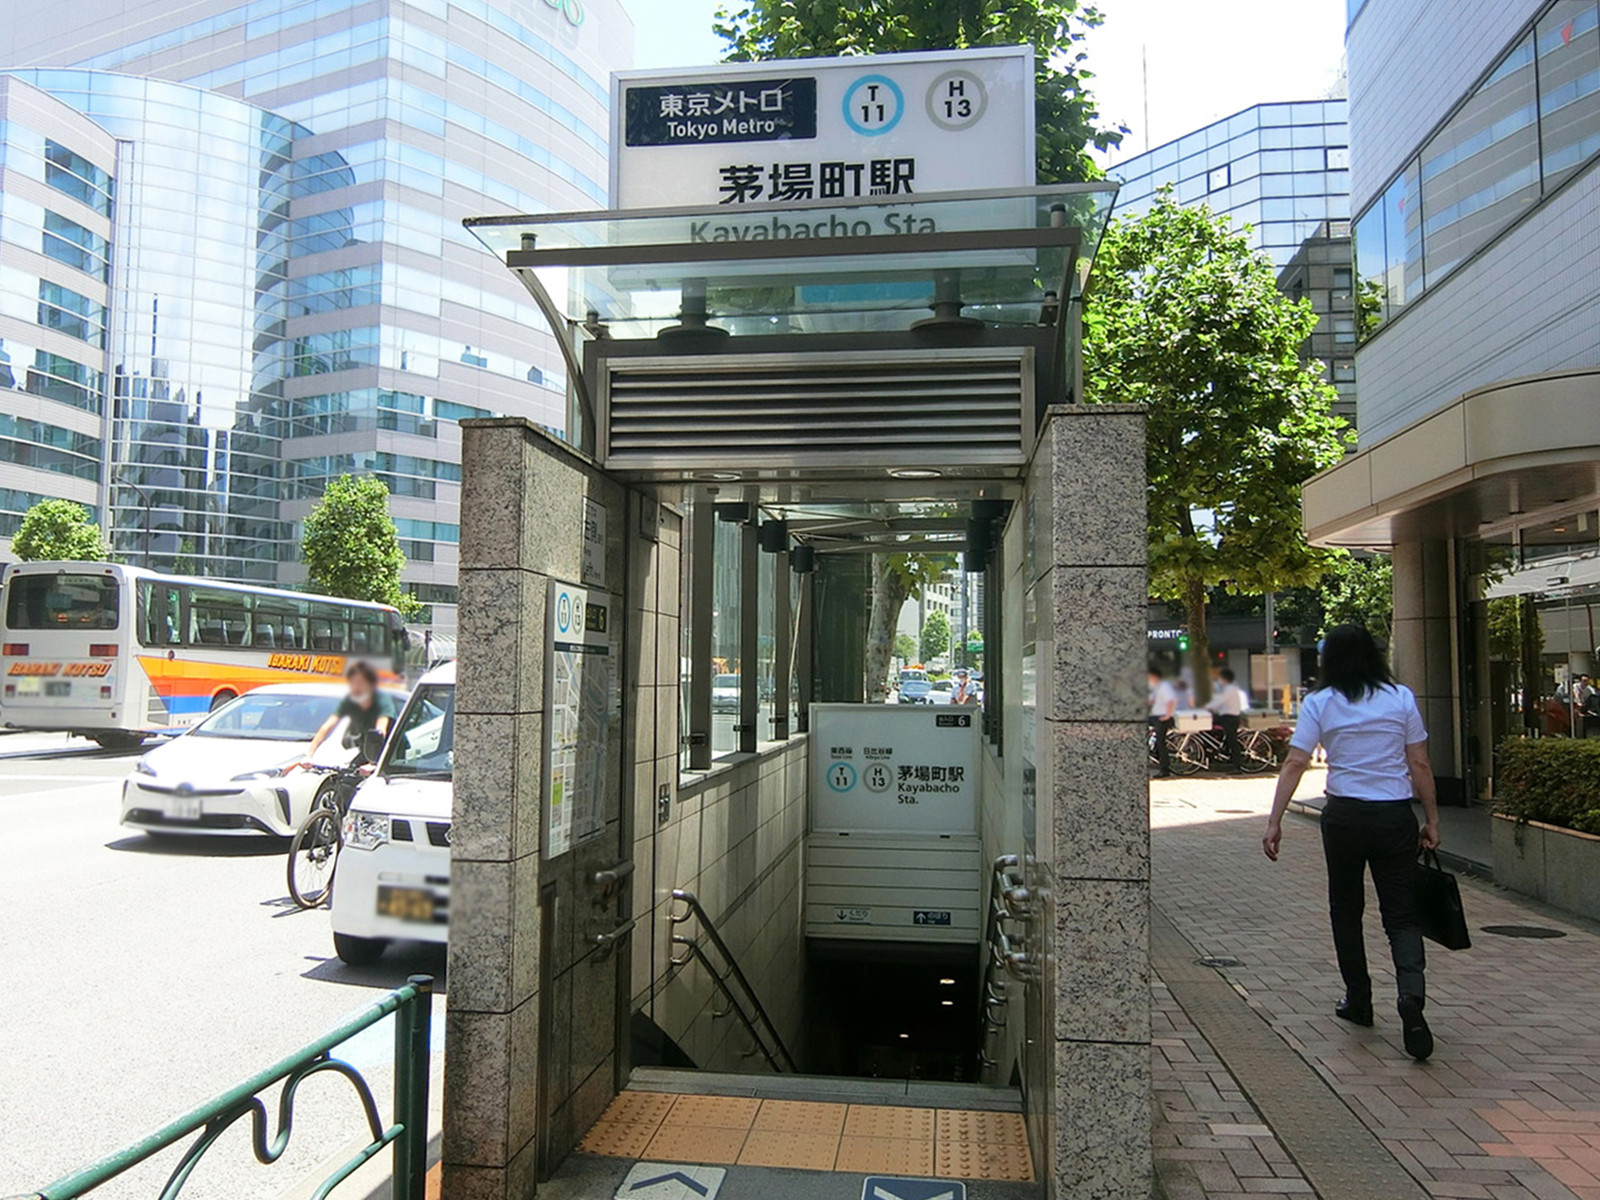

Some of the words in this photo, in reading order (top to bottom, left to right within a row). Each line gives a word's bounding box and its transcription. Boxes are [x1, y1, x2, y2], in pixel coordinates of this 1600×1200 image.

[867, 85, 879, 102] T
[949, 81, 964, 97] H
[659, 89, 783, 118] 東京メトロ
[944, 100, 971, 118] 13
[861, 104, 885, 123] 11
[667, 121, 718, 141] Tokyo
[722, 119, 775, 135] Metro
[719, 158, 915, 205] 茅場町駅
[690, 214, 872, 244] Kayabacho
[62, 663, 111, 677] KOTSU
[268, 653, 310, 672] IBARAKI
[958, 715, 966, 726] 6
[839, 766, 845, 776] T
[874, 767, 883, 776] H
[898, 765, 965, 781] 茅場町駅
[836, 776, 848, 786] 11
[872, 777, 886, 787] 13
[898, 782, 960, 794] Kayabacho
[898, 794, 919, 804] Sta.
